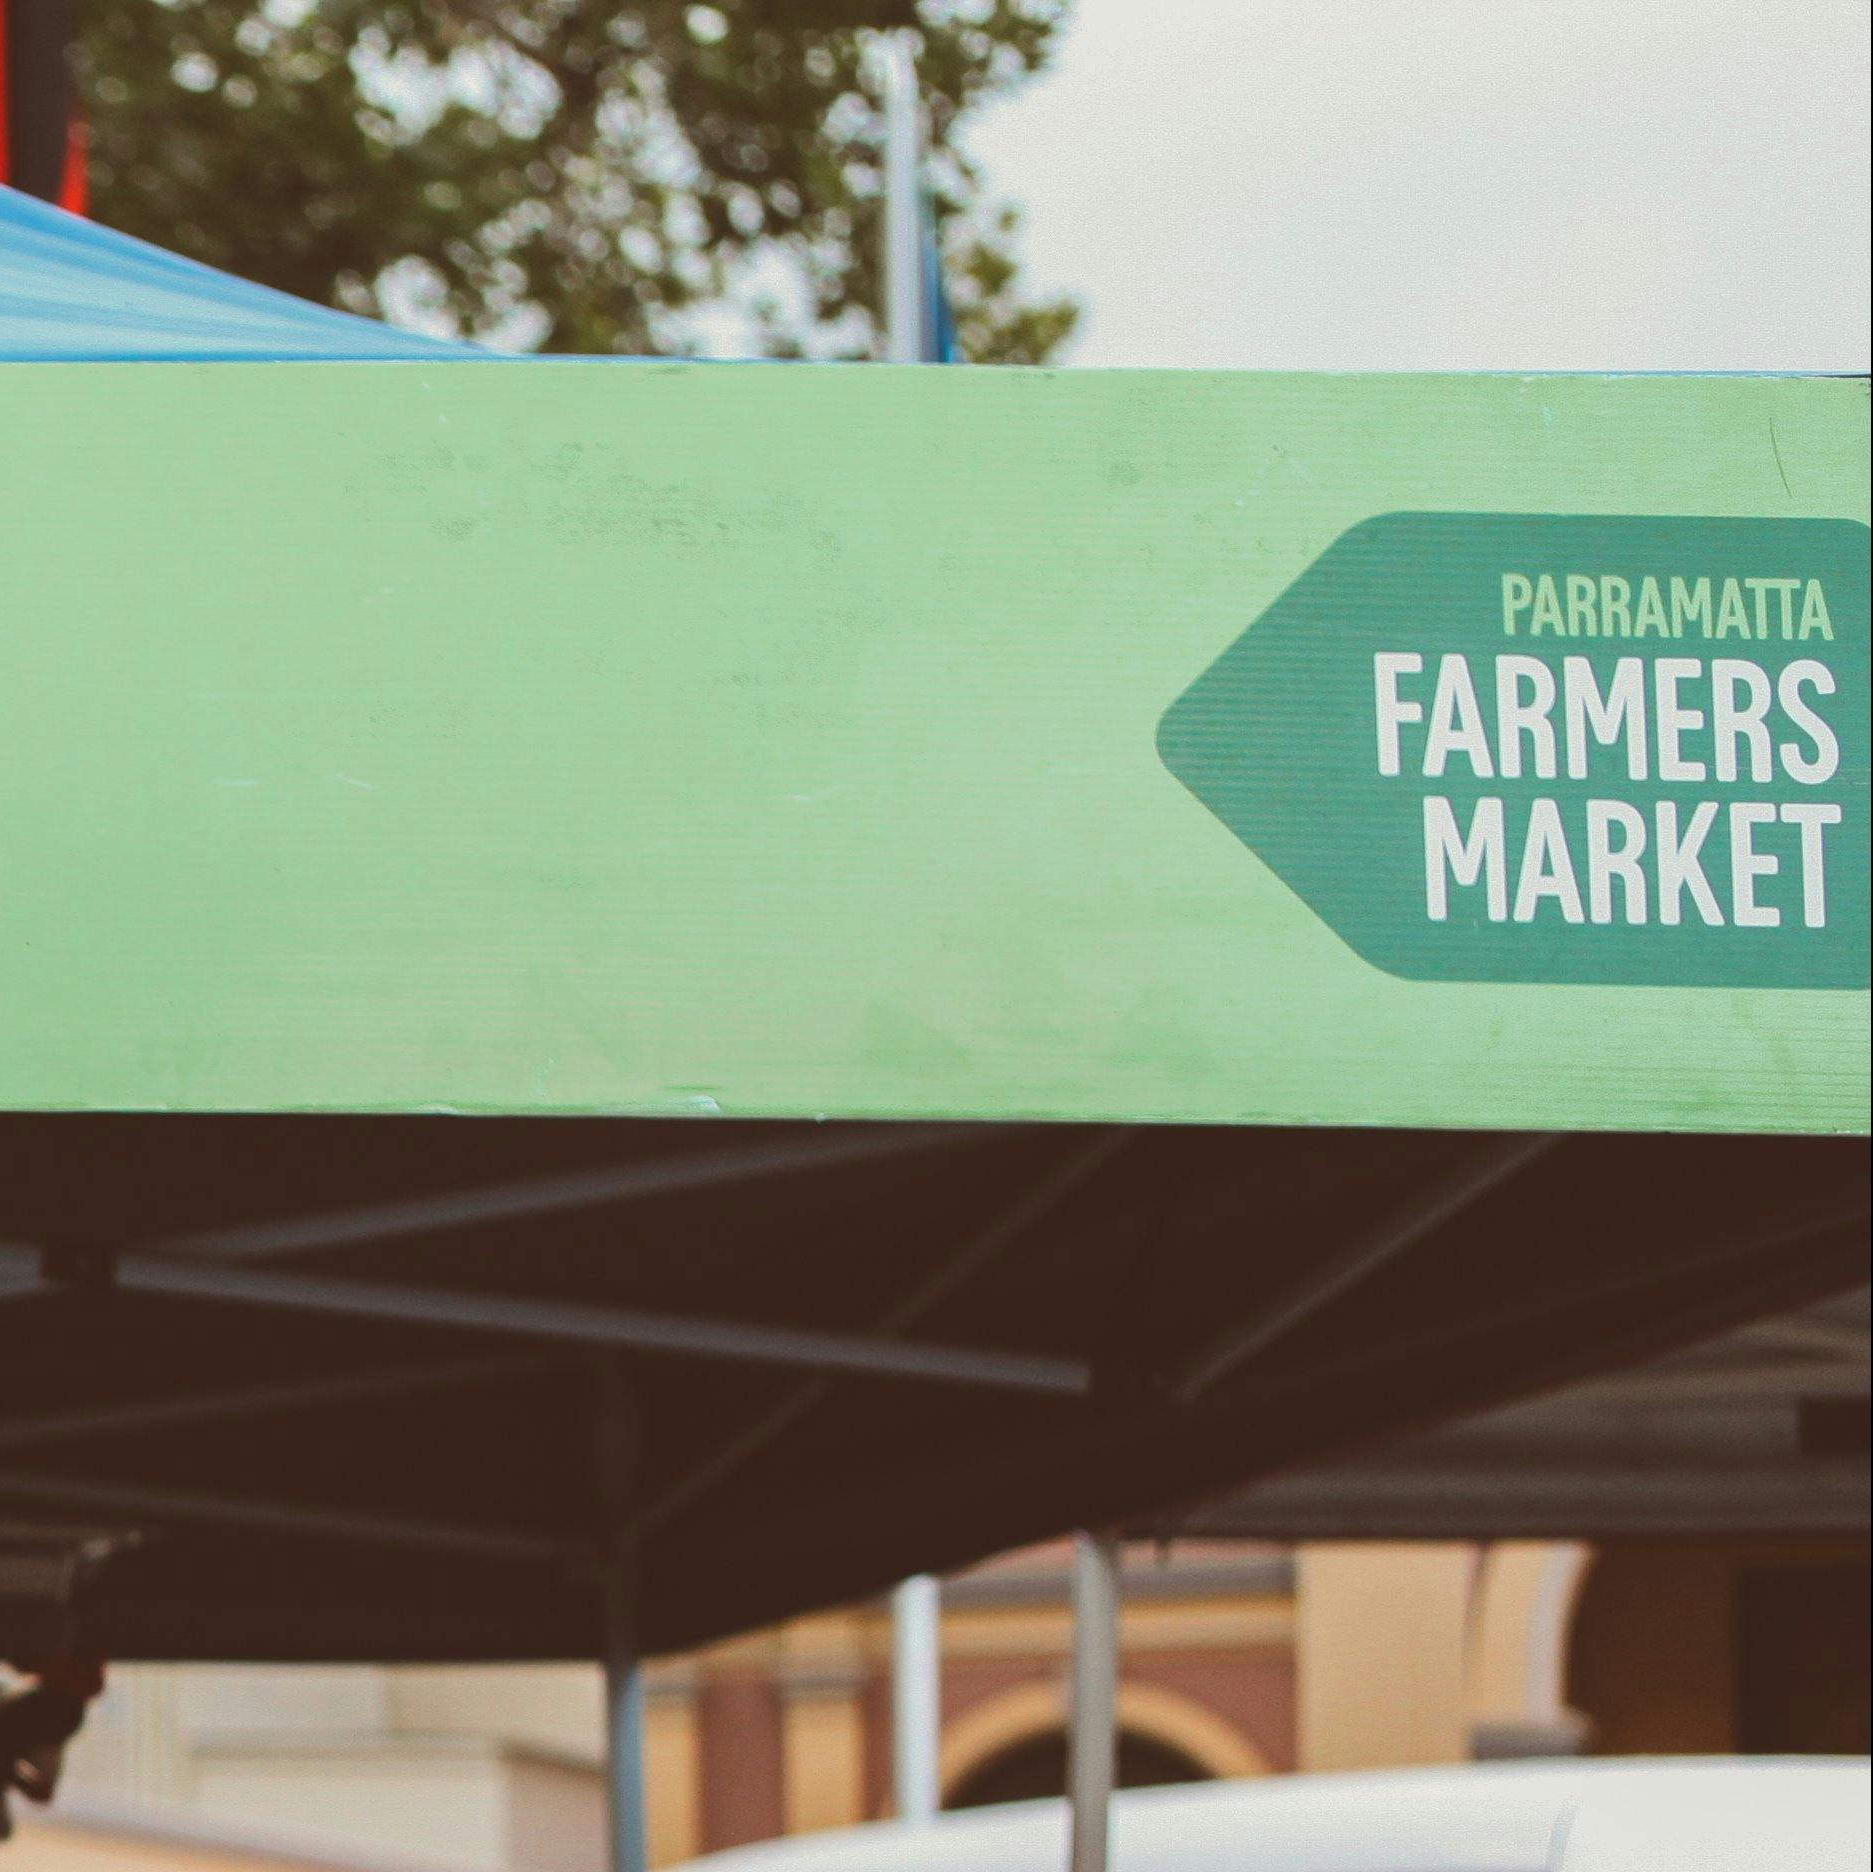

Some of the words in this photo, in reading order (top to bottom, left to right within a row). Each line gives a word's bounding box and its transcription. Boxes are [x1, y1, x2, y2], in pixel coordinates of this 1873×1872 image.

[1501, 572, 1835, 641] PARRAMATTA
[1372, 651, 1841, 786] FARMERS
[1421, 794, 1843, 929] MARKET
